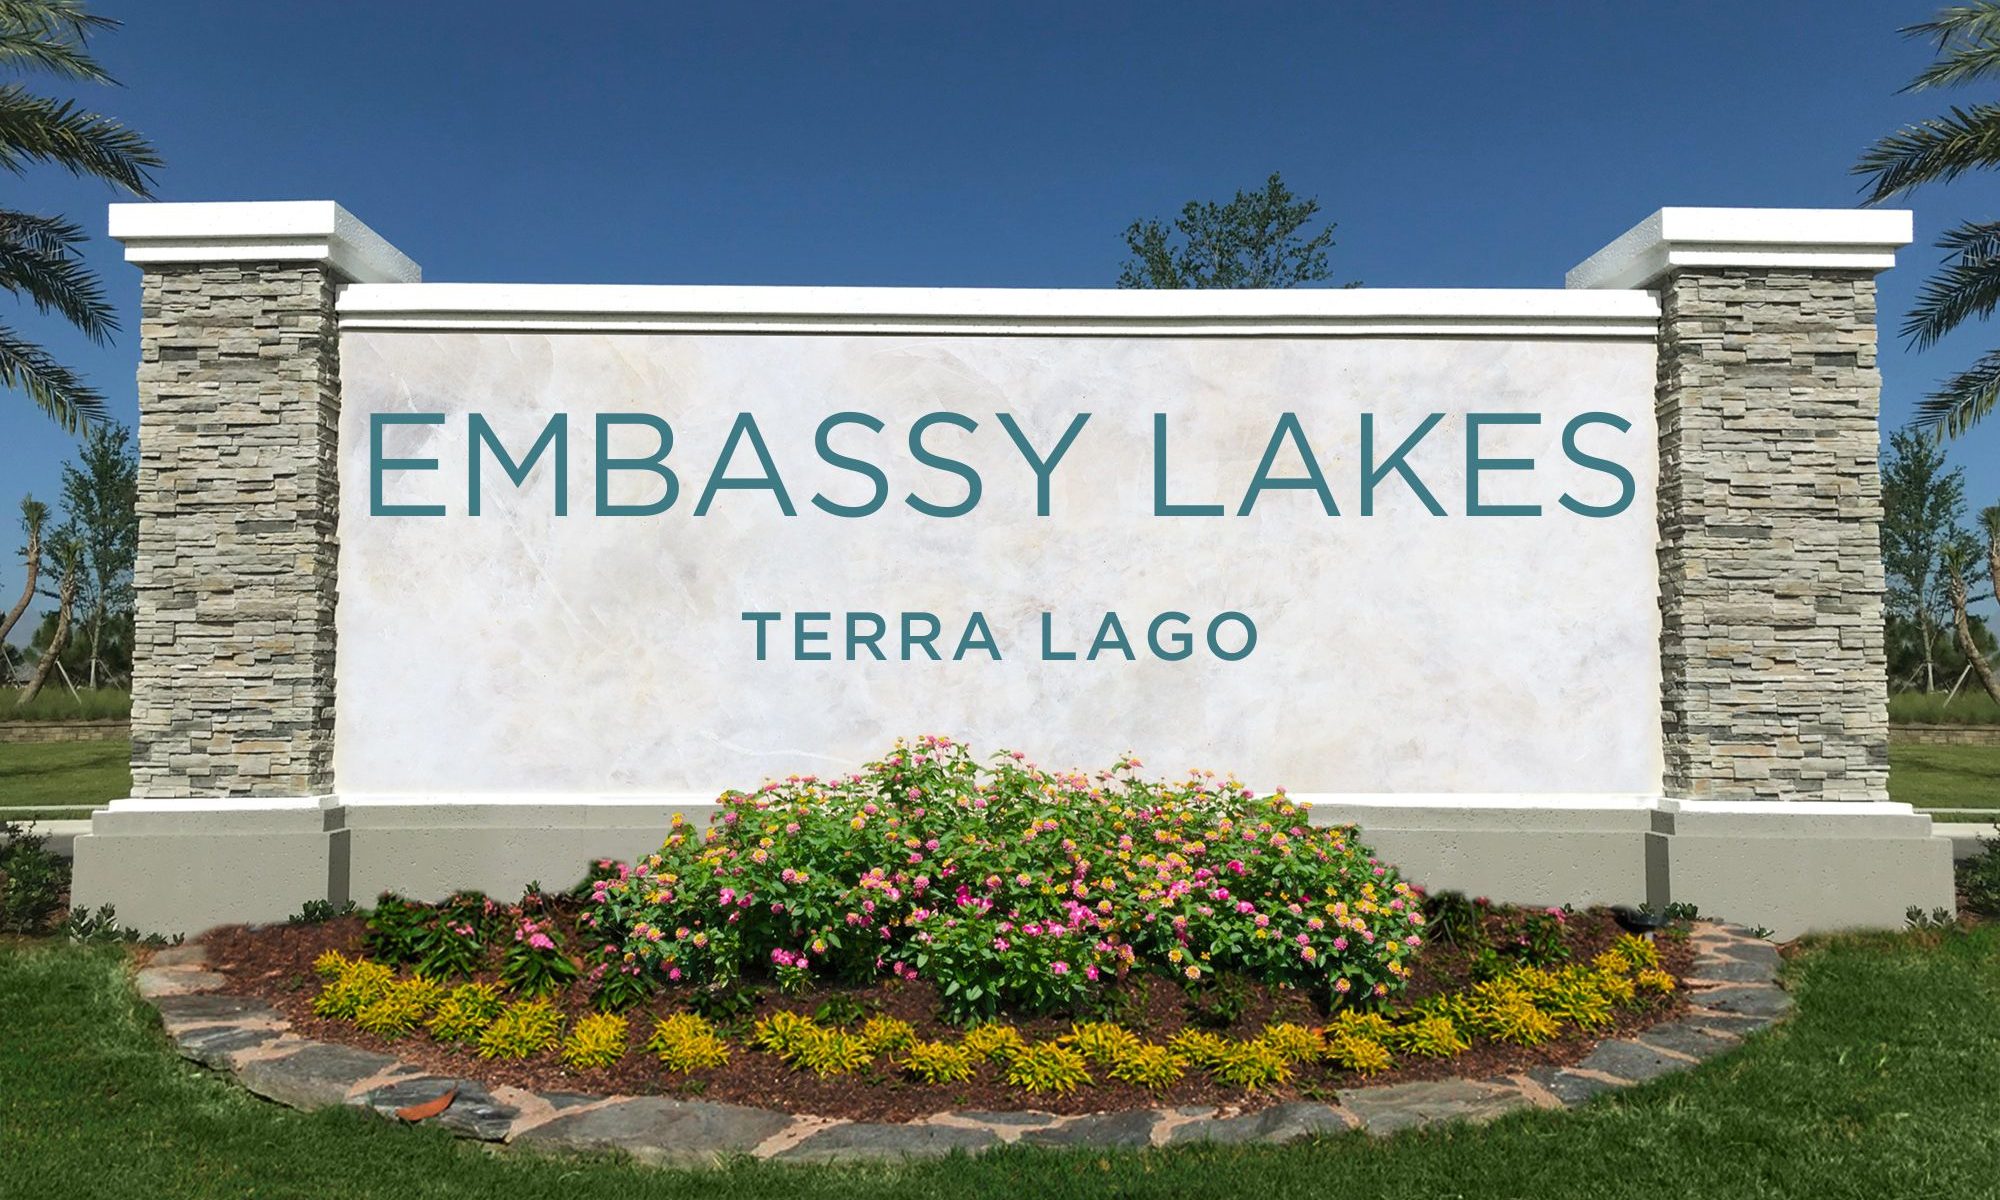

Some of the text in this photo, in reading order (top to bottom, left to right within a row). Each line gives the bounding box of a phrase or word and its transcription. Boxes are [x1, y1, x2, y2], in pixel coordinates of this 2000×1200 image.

[370, 412, 1635, 517] EMBASSY LAKES
[742, 611, 1257, 661] TERRA LAGO
